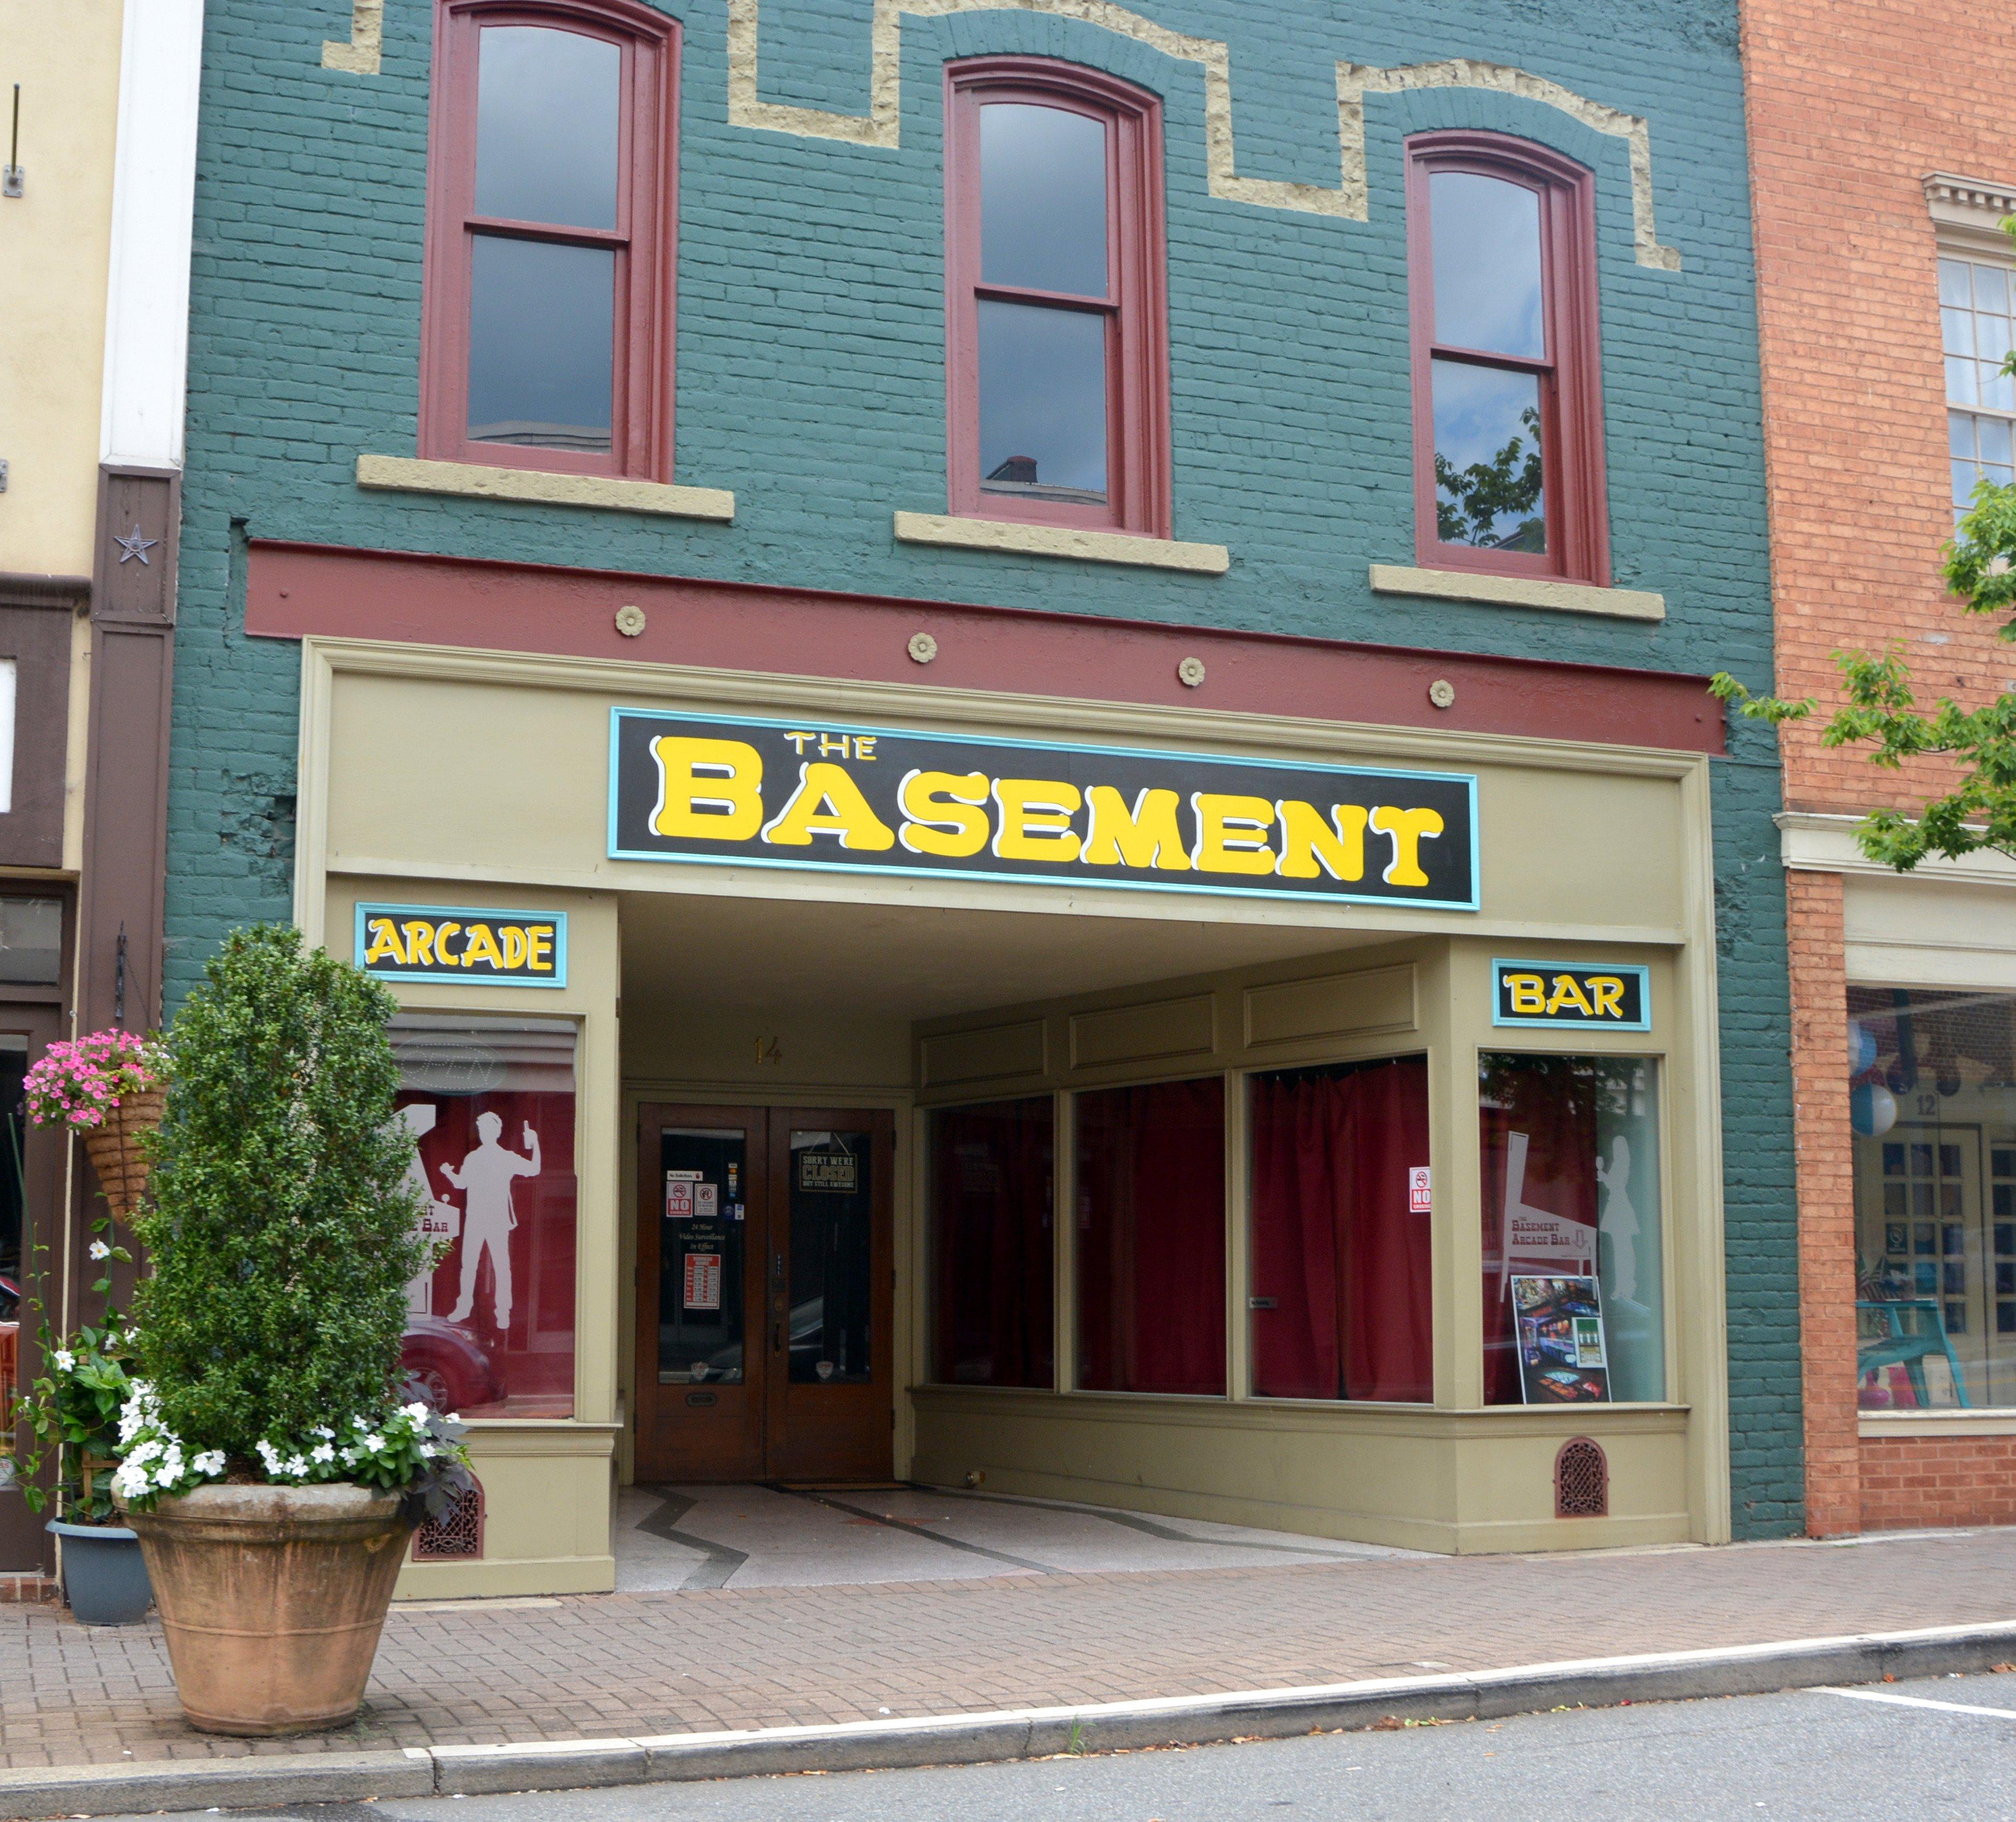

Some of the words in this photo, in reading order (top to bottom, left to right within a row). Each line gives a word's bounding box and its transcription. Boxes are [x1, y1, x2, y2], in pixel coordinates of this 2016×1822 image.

[784, 731, 877, 761] THE
[650, 736, 1445, 887] BASEMENT
[365, 918, 554, 971] ARCADE
[1503, 974, 1624, 1019] BAR
[756, 1036, 782, 1065] 14
[1917, 1095, 1935, 1116] 12
[803, 1156, 828, 1164] SORRY
[802, 1164, 854, 1182] CLOSED
[670, 1199, 689, 1211] NO
[1413, 1190, 1431, 1204] NO
[423, 1218, 449, 1232] BAR
[1512, 1220, 1560, 1232] BASEMENT
[1512, 1233, 1549, 1245] ARCADE
[1551, 1233, 1570, 1245] BAR
